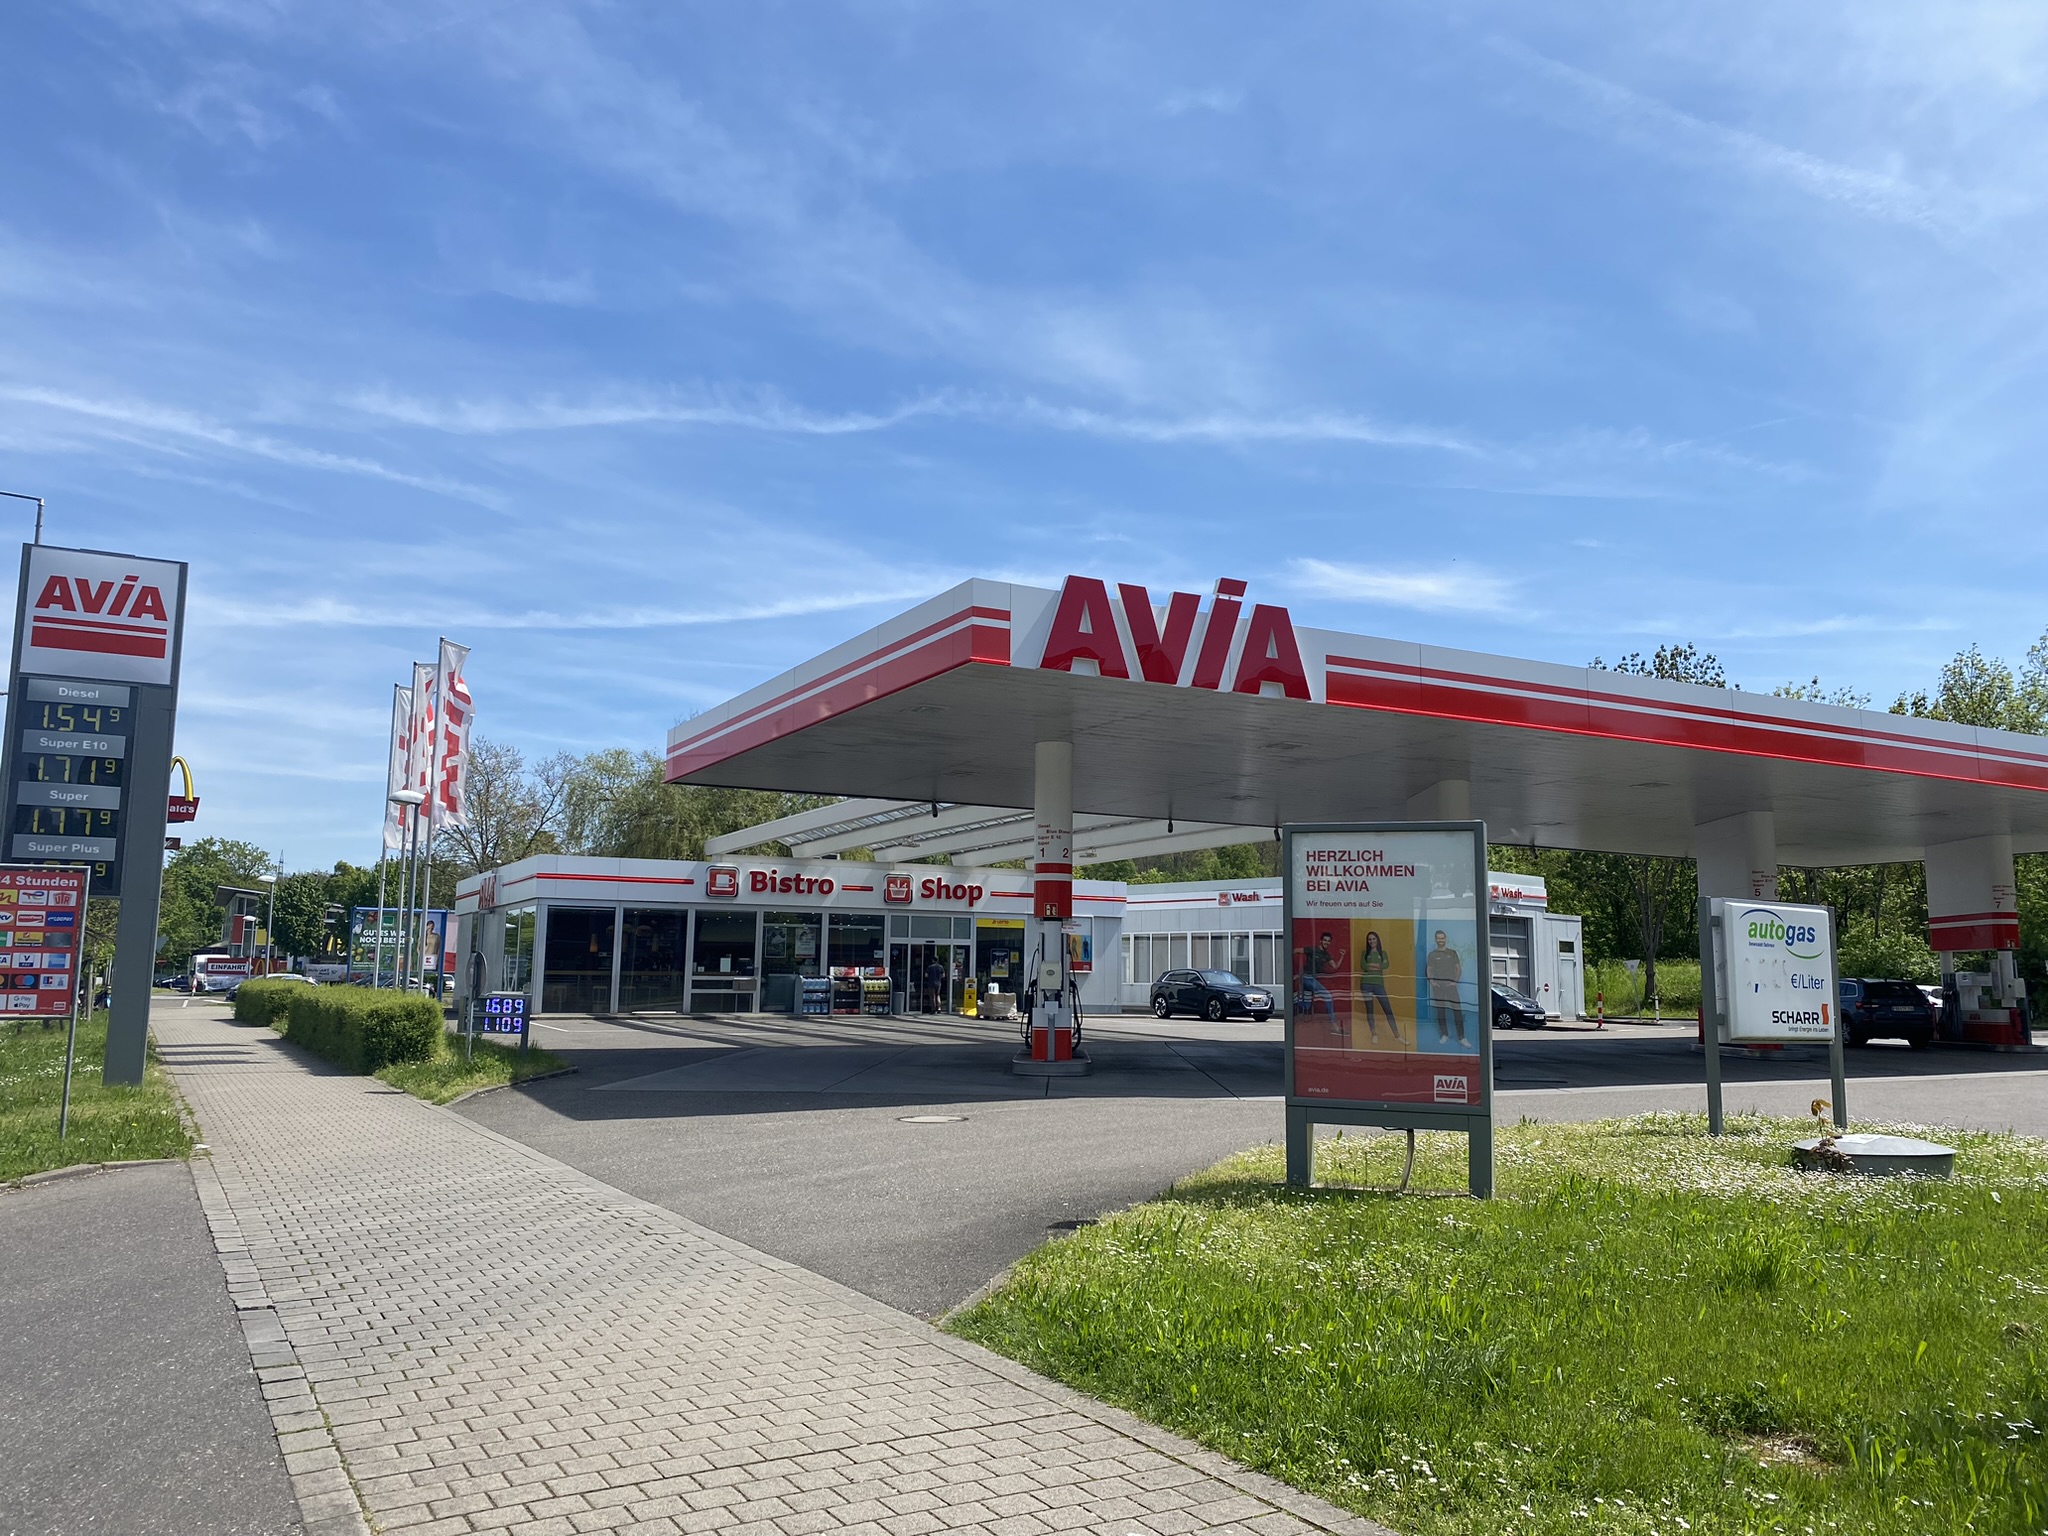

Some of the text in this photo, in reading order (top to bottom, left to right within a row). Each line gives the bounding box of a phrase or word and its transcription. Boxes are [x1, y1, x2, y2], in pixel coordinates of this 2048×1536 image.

[34, 574, 168, 622] AVIA
[1040, 574, 1313, 701] AVIA
[58, 686, 99, 699] Diesel
[39, 737, 108, 751] Super E10
[49, 790, 89, 802] Super
[28, 841, 100, 854] Super Plus
[1040, 847, 1069, 858] 1 2
[1306, 850, 1383, 862] HERZLICH
[1305, 865, 1415, 877] WILLKOMMEN
[0, 874, 78, 887] 4 Stunden
[750, 869, 834, 895] Bistro
[1306, 880, 1370, 892] BEI AVIA
[920, 877, 983, 907] Shop
[1232, 891, 1260, 902] Wash
[1501, 887, 1523, 899] Wash
[1754, 888, 1761, 897] 5
[1748, 919, 1816, 947] autogas
[210, 963, 246, 971] EINFAHRT
[1790, 973, 1825, 990] €/Liter
[1771, 1010, 1820, 1025] SCHARR
[1435, 1077, 1466, 1090] AVIA
